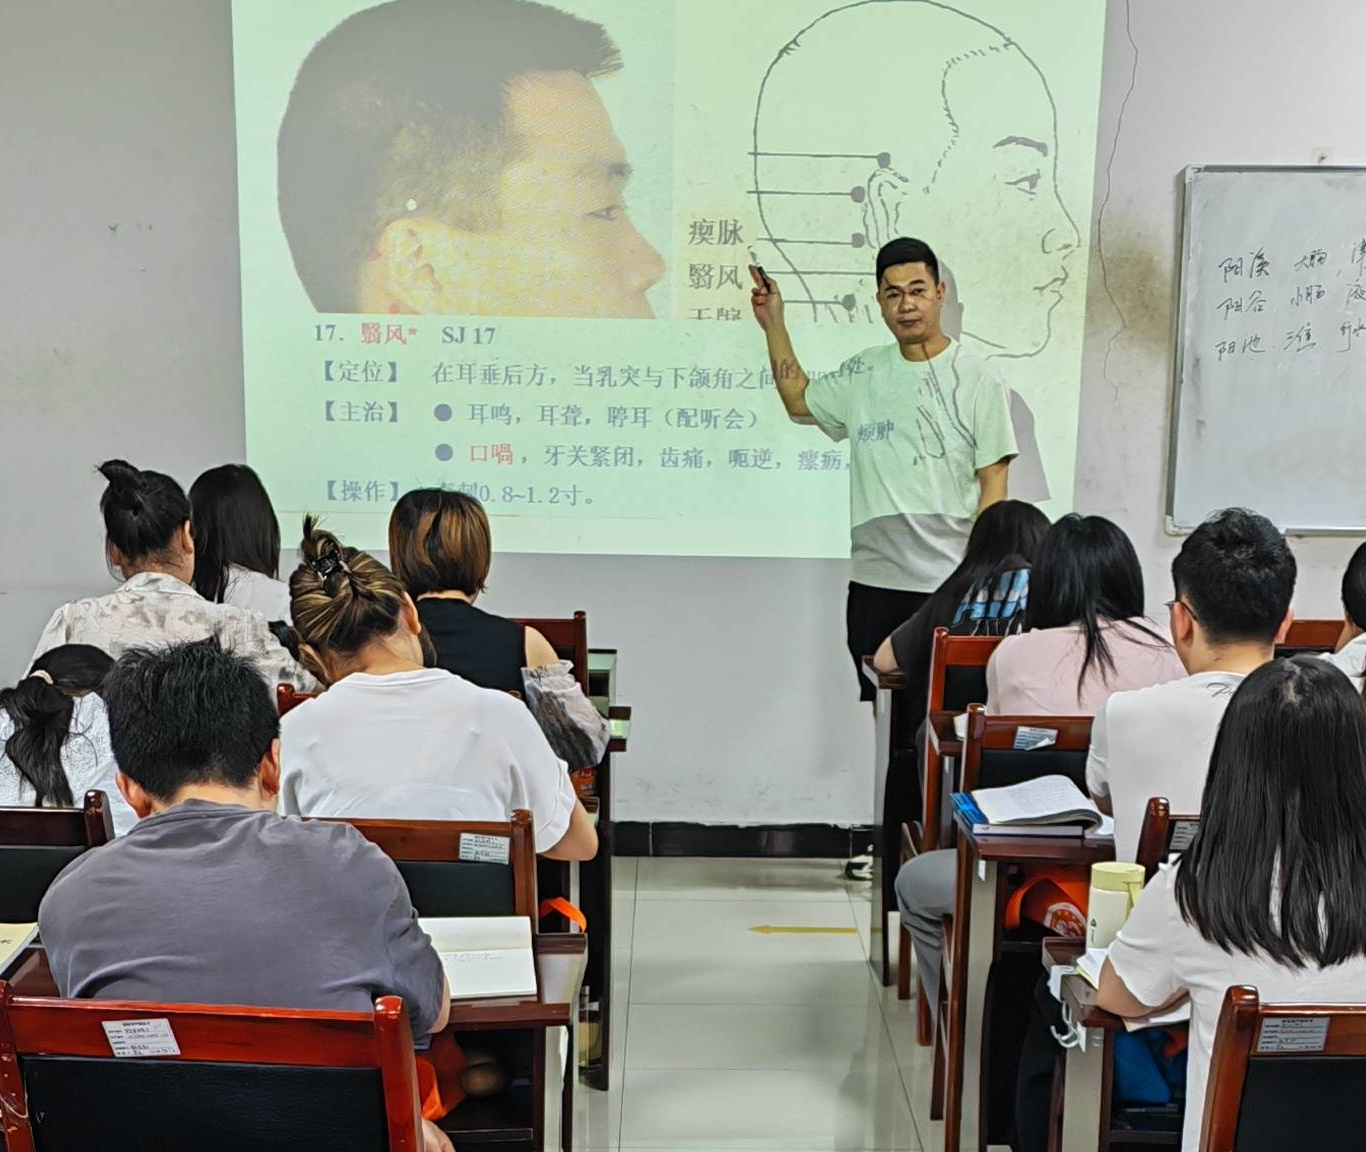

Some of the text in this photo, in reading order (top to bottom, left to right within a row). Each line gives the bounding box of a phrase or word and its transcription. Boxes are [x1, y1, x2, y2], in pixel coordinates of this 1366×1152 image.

[441, 326, 466, 344] SJ
[473, 326, 496, 345] 17
[324, 360, 398, 383] 【定位】
[325, 400, 399, 423] 【主治】
